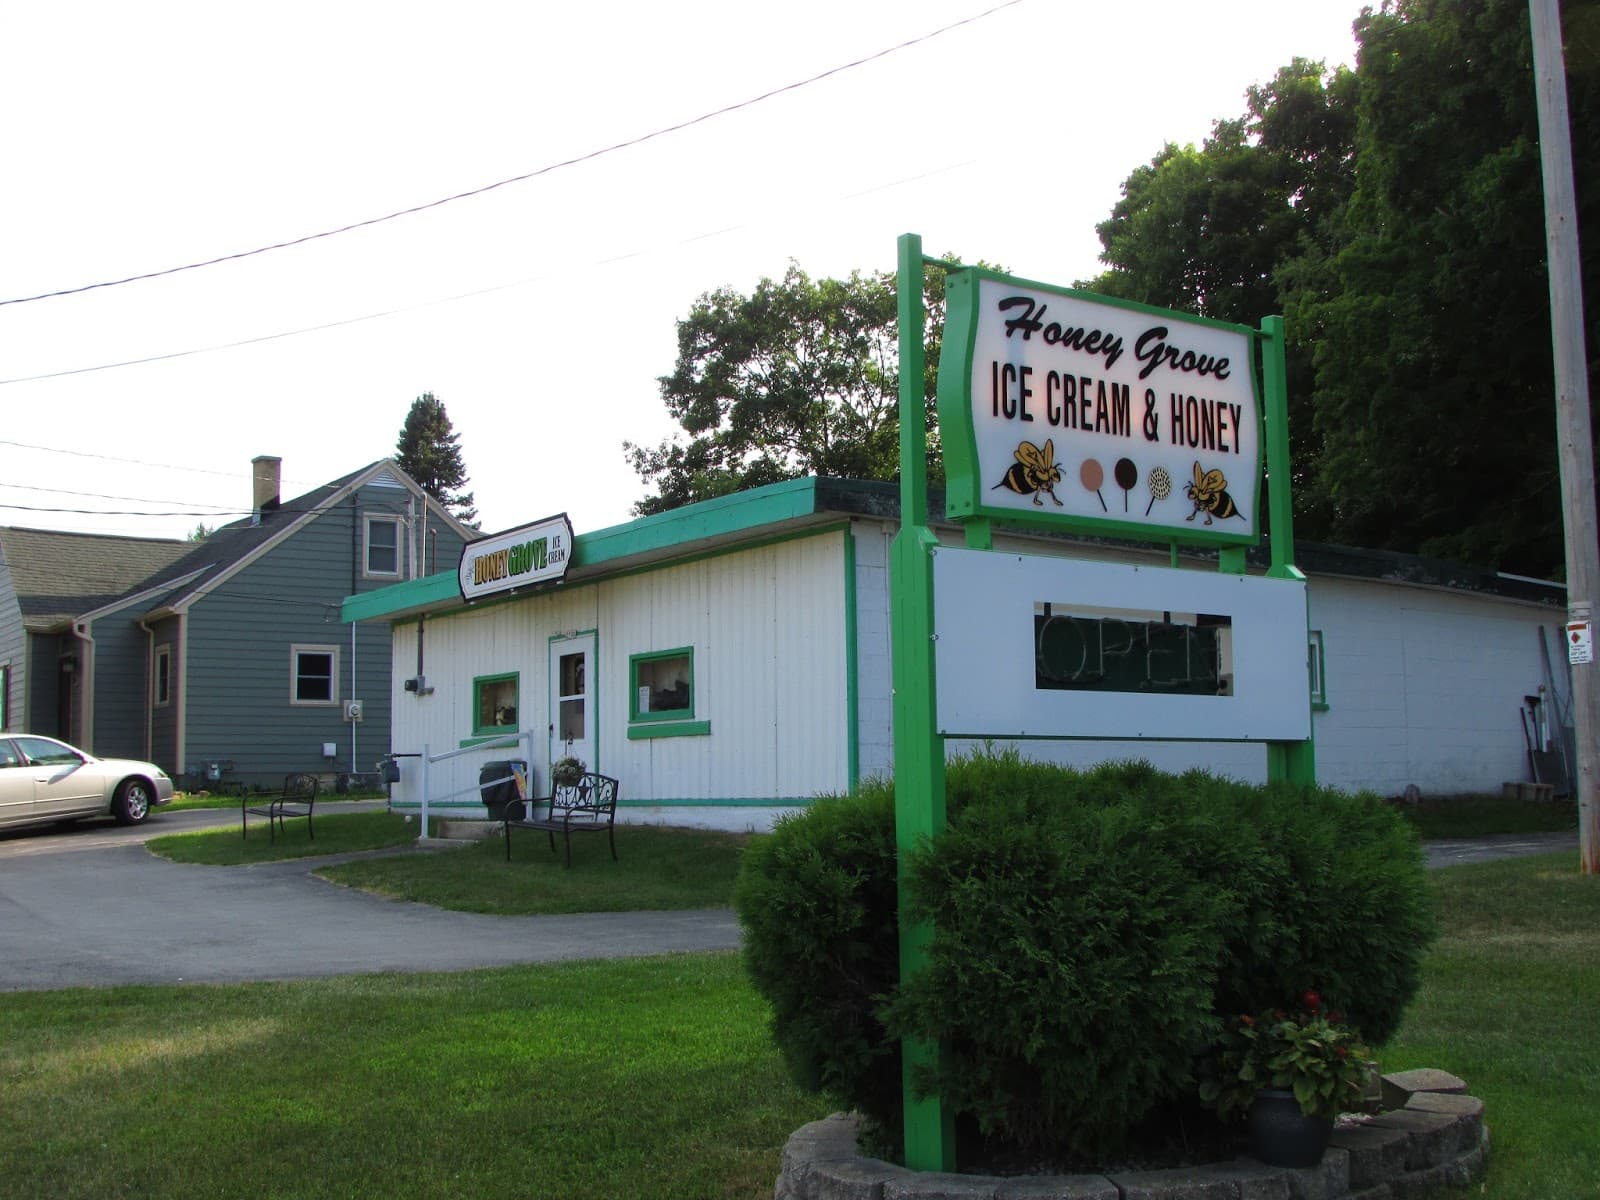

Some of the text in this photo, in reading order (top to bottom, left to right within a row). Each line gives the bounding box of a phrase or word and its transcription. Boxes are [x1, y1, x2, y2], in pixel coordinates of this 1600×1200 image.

[998, 296, 1231, 380] Honey Grove
[992, 361, 1242, 454] ICE CREAM & HONEY
[474, 548, 508, 586] HONEY
[508, 536, 547, 577] GROVE
[548, 549, 565, 564] CREAM
[552, 535, 561, 549] ICE
